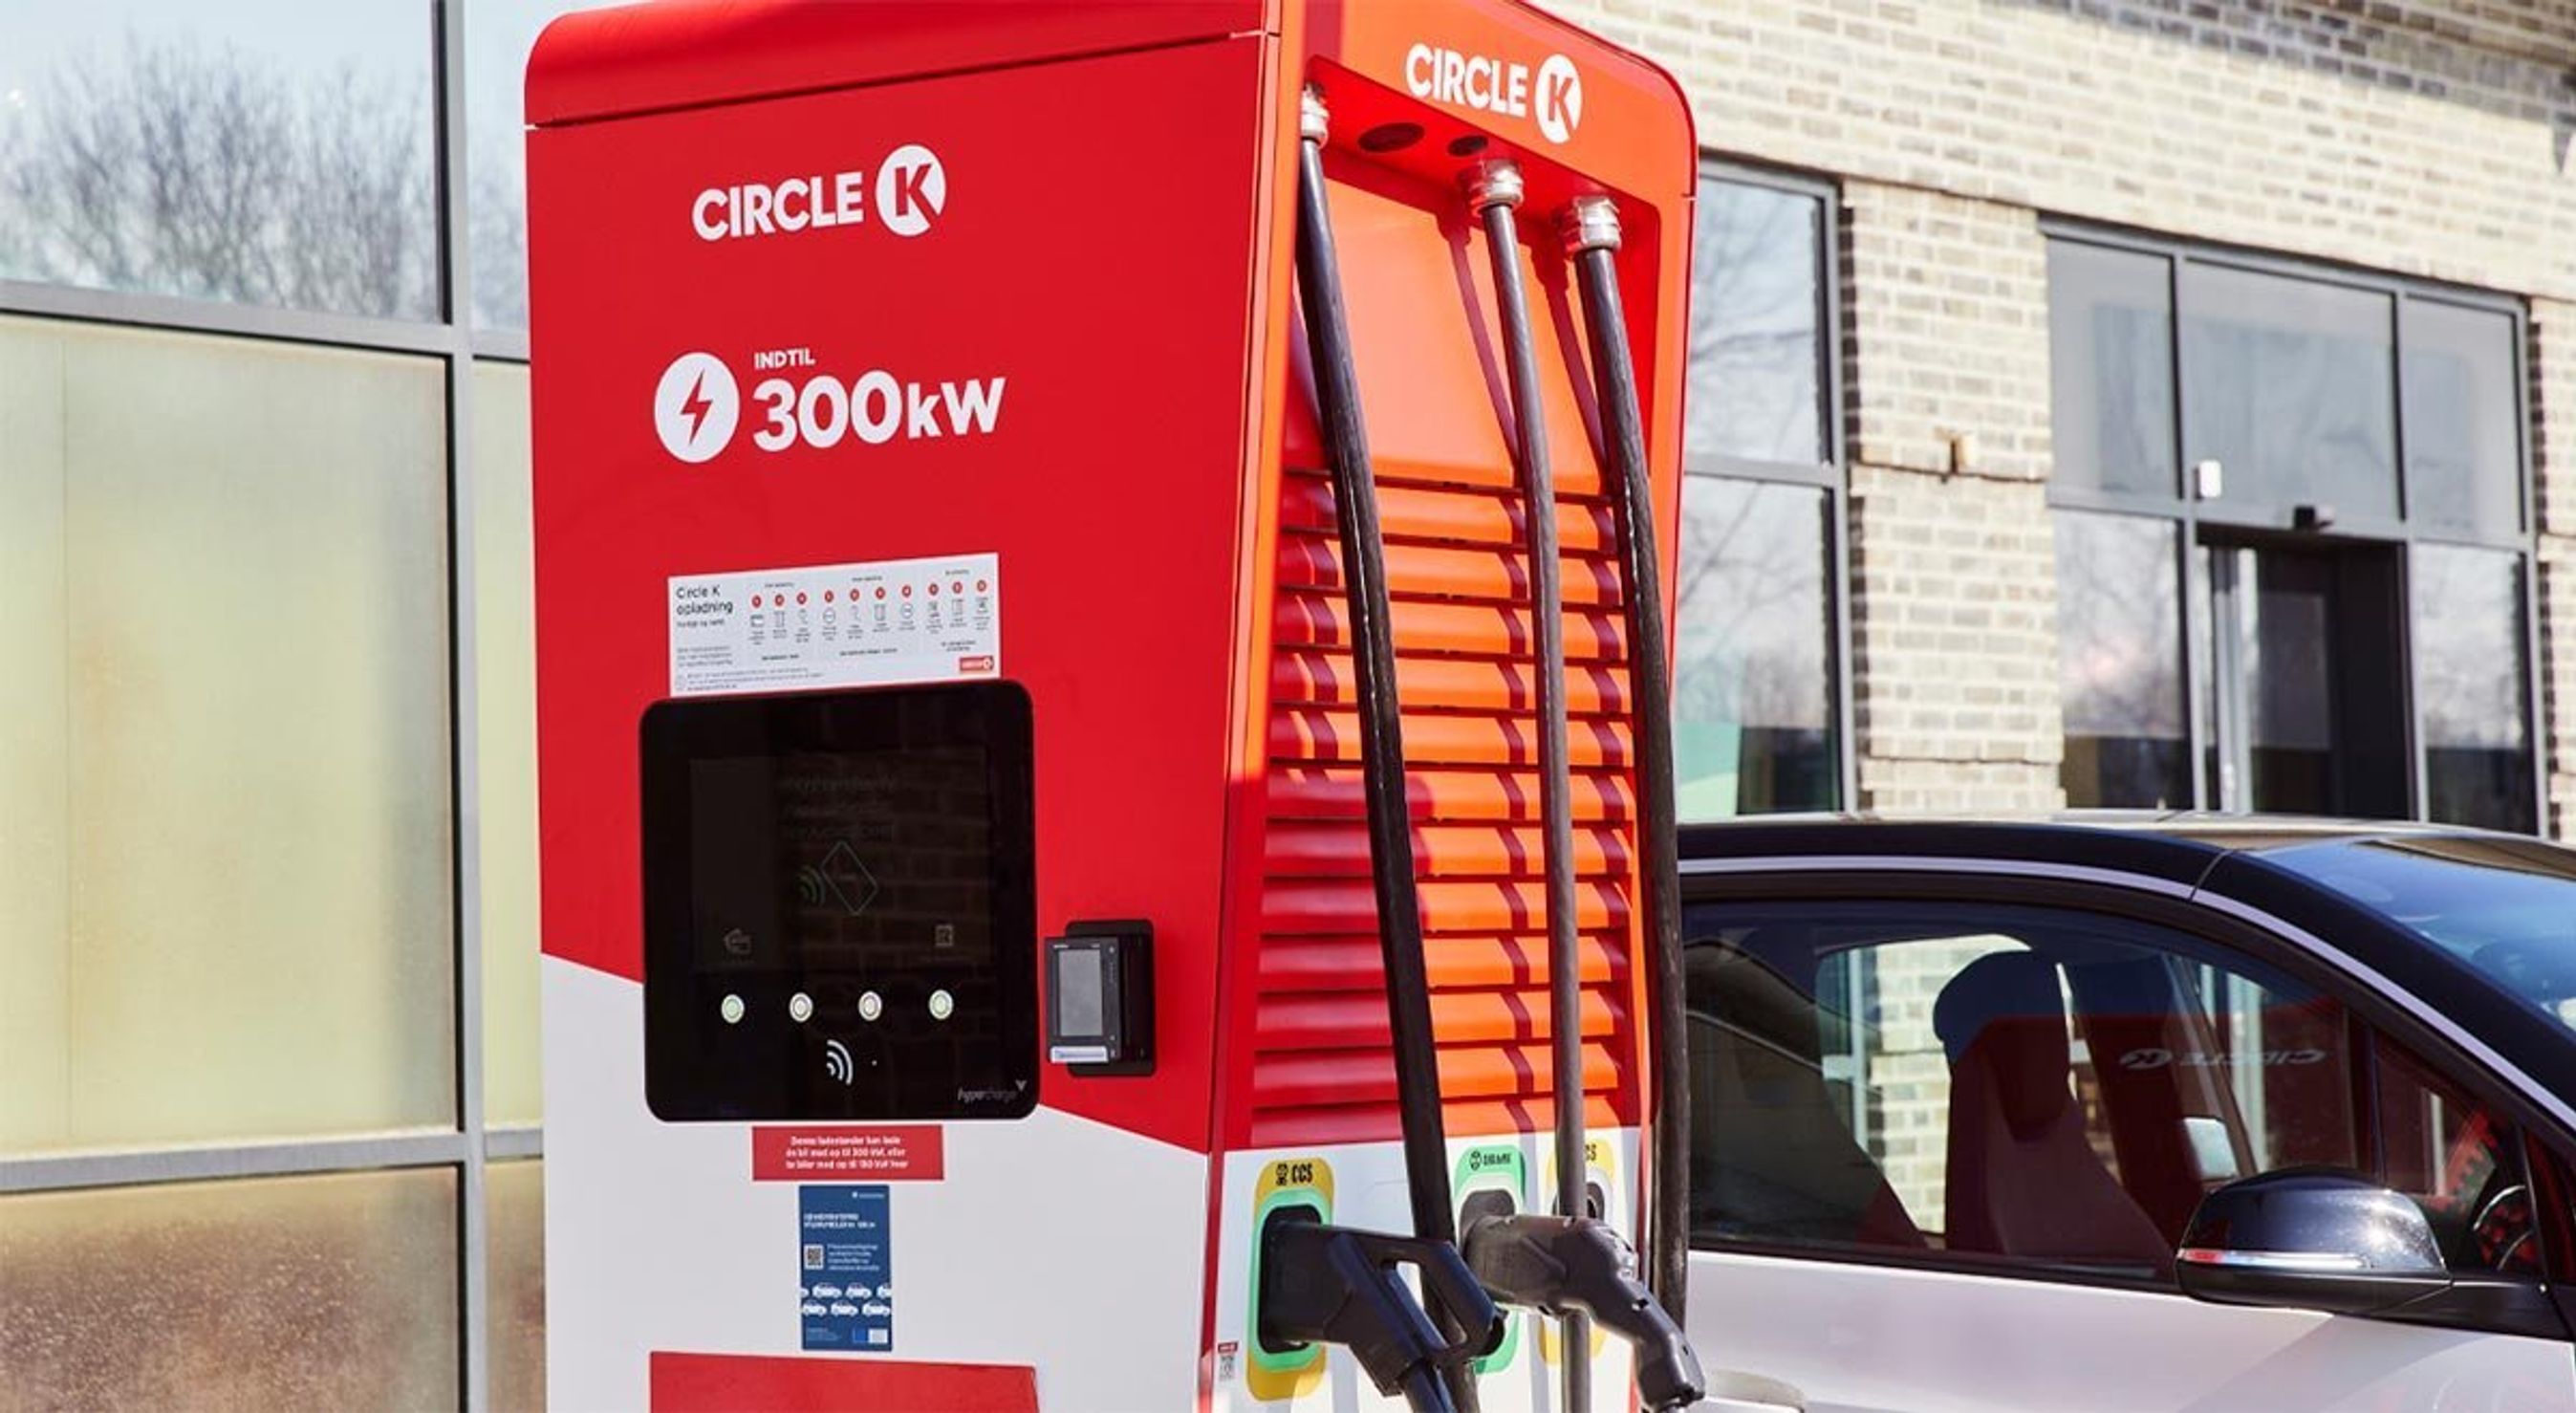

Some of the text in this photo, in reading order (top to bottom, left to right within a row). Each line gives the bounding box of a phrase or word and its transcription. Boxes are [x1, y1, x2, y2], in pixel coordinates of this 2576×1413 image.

[1405, 42, 1581, 141] CIRCLE K
[692, 154, 944, 241] CIRCLE K
[754, 348, 815, 369] INDTIL
[752, 370, 1006, 452] 300kW
[676, 584, 721, 598] Circle K
[676, 600, 733, 616] opladning
[1291, 1163, 1313, 1184] CCS
